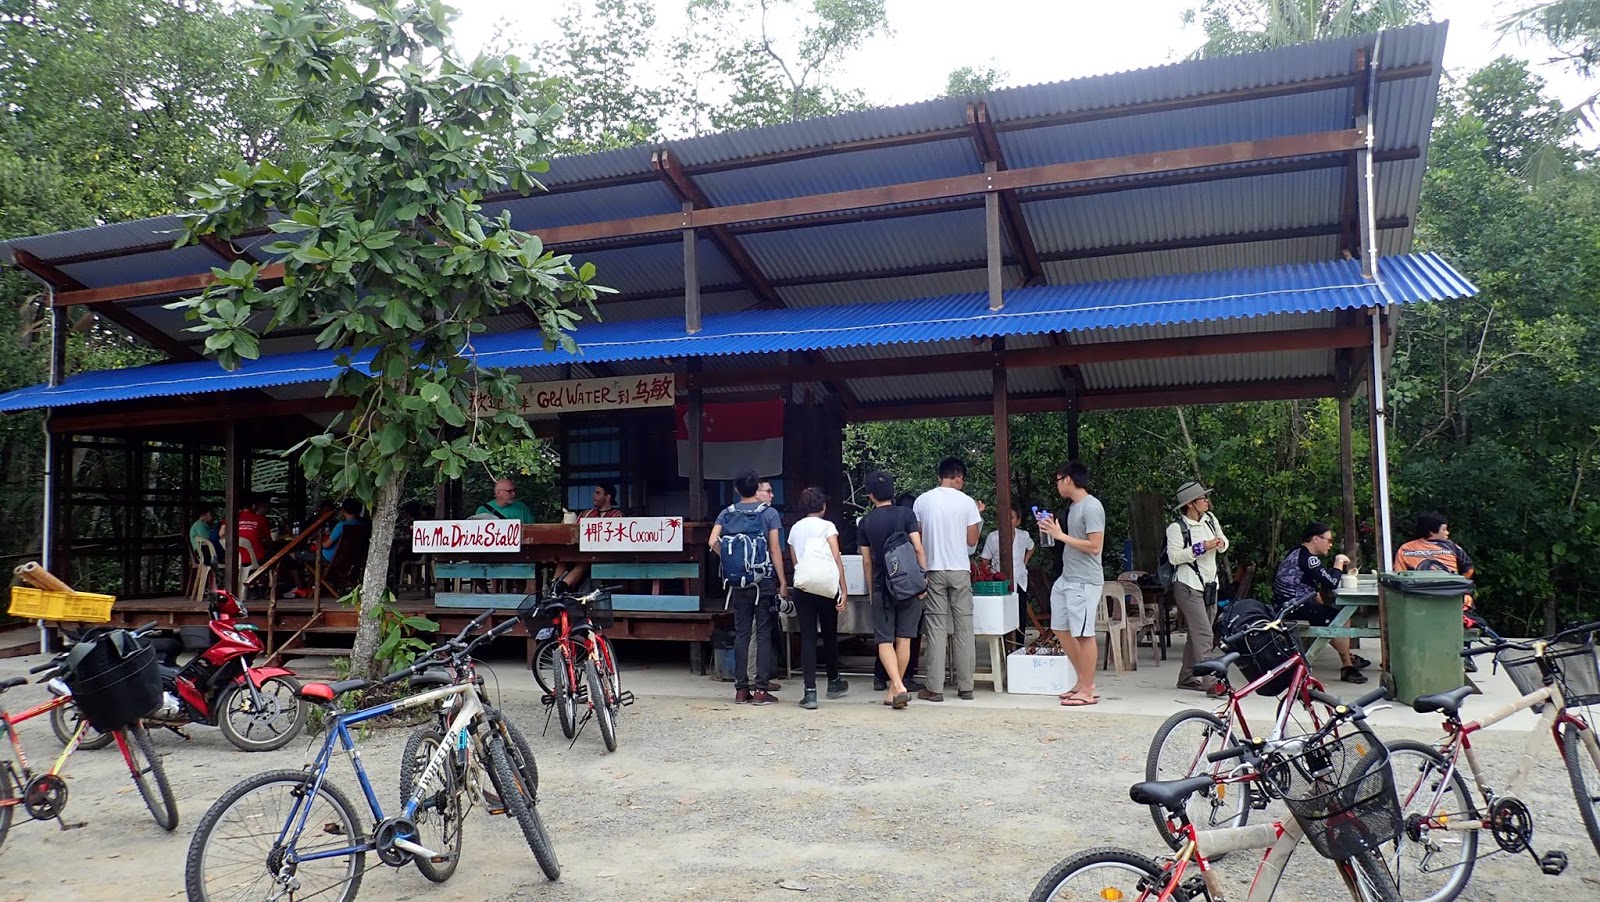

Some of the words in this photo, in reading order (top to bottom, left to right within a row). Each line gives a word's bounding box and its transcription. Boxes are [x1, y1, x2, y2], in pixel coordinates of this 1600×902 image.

[566, 382, 618, 405] WATER
[414, 527, 430, 547] Ah
[431, 526, 450, 547] Ma
[451, 524, 484, 548] Drink
[484, 522, 520, 547] Stall
[584, 521, 629, 543] 椰子水
[629, 520, 666, 543] Coconut
[422, 730, 457, 786] WHEELER
